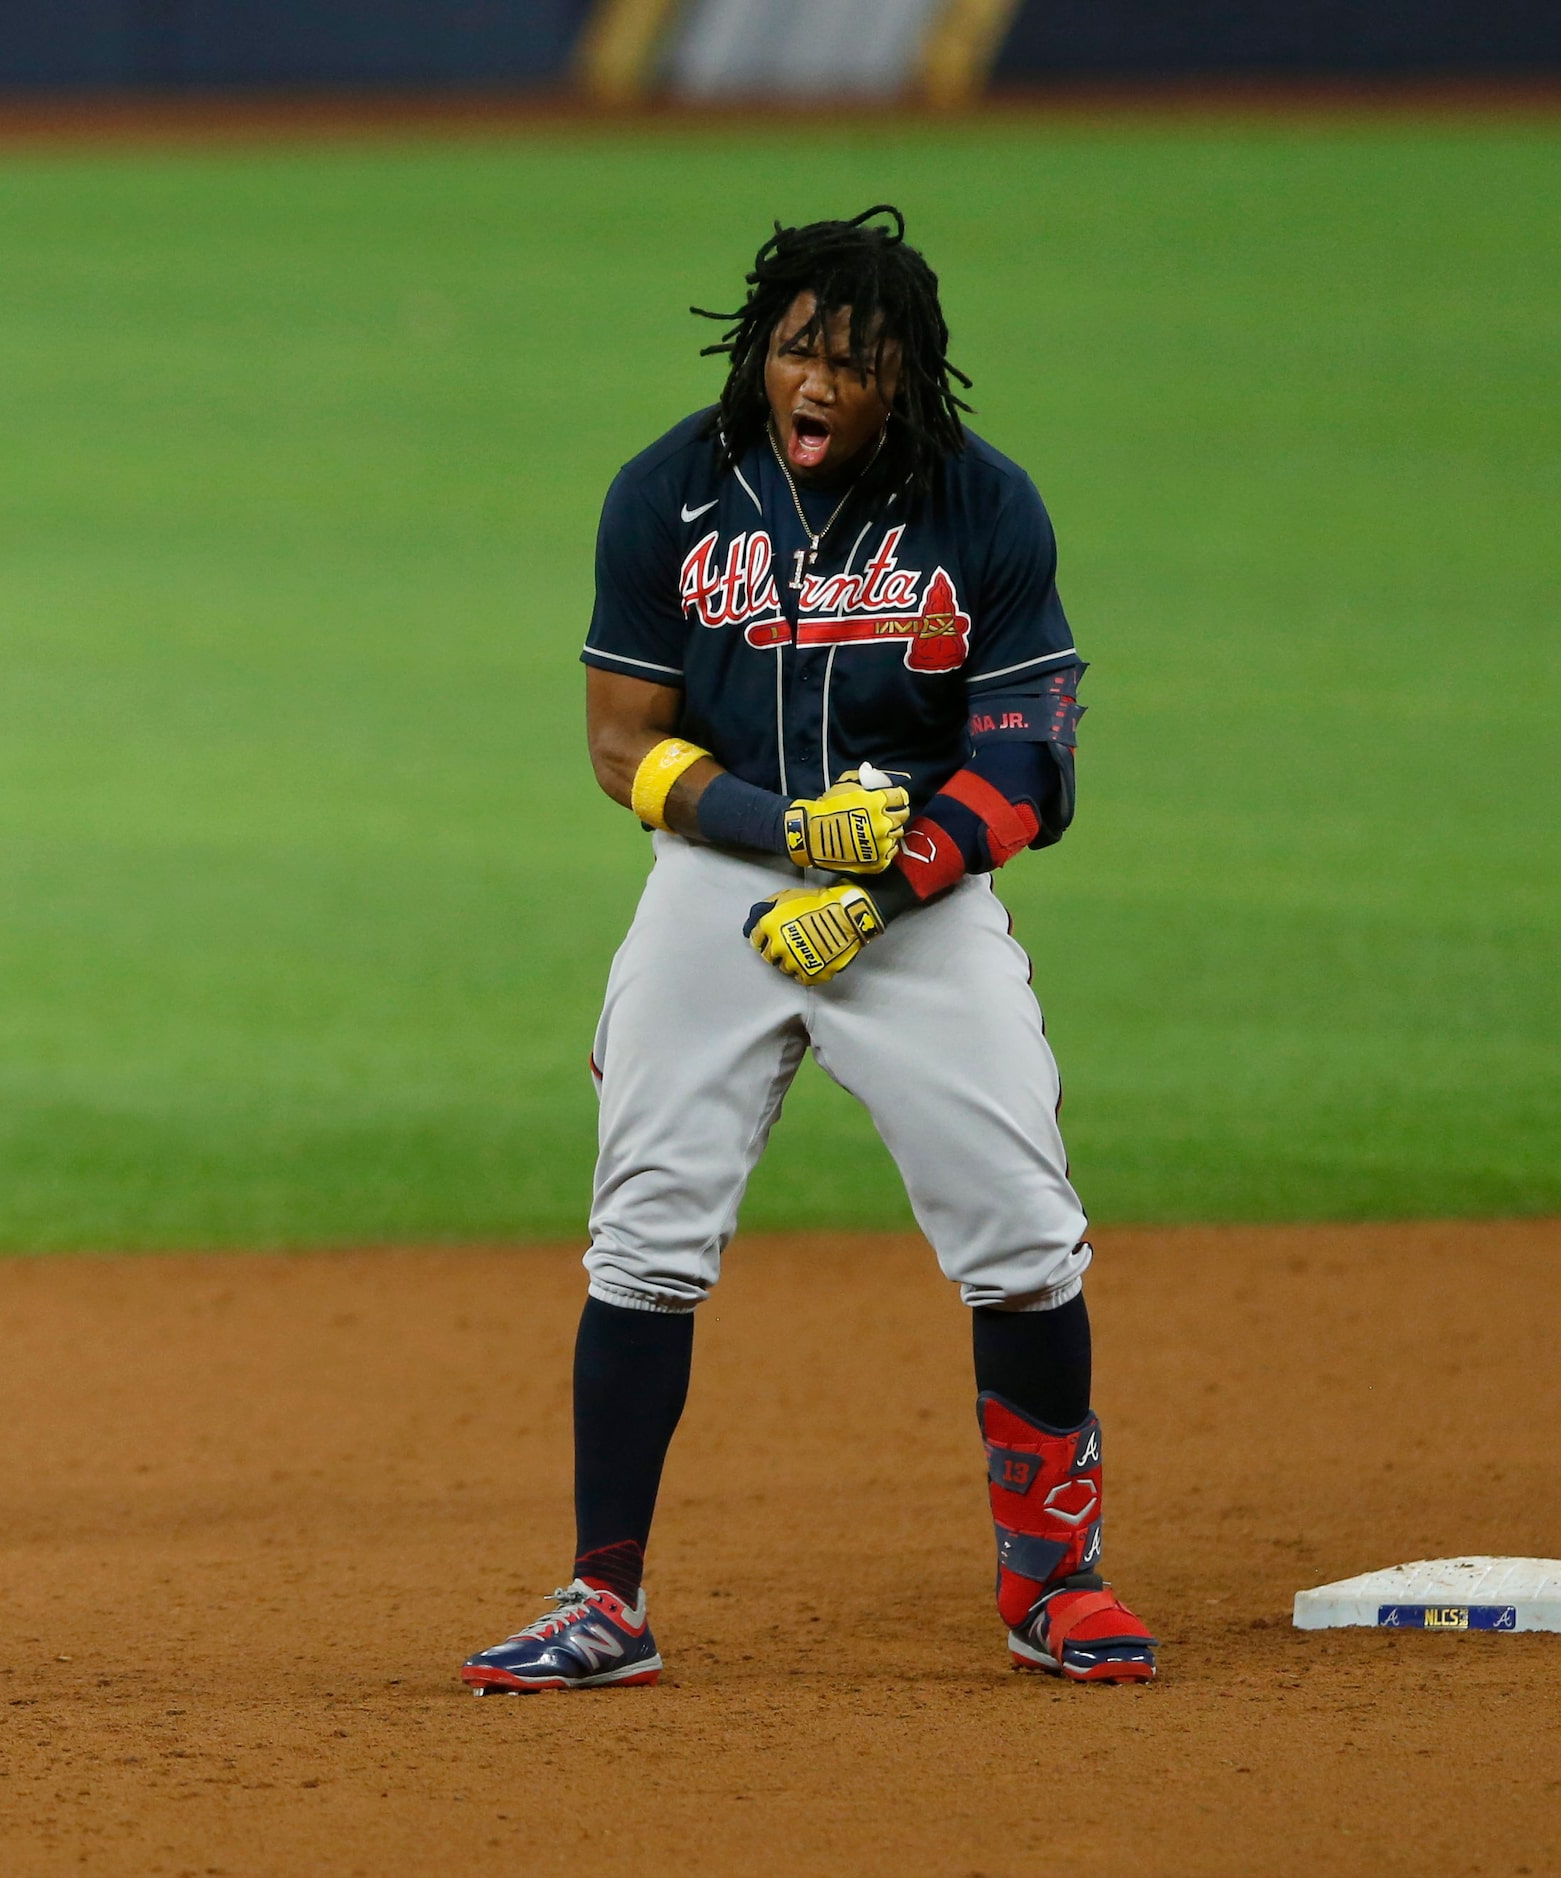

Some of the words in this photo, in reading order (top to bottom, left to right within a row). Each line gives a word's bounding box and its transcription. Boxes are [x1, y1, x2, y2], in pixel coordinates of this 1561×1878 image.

[999, 711, 1029, 730] JR.
[1076, 1431, 1099, 1467] A
[1002, 1460, 1031, 1485] 13
[1083, 1526, 1101, 1563] A
[1381, 1607, 1400, 1627] A
[1424, 1608, 1459, 1627] NLCS
[1493, 1608, 1513, 1628] A
